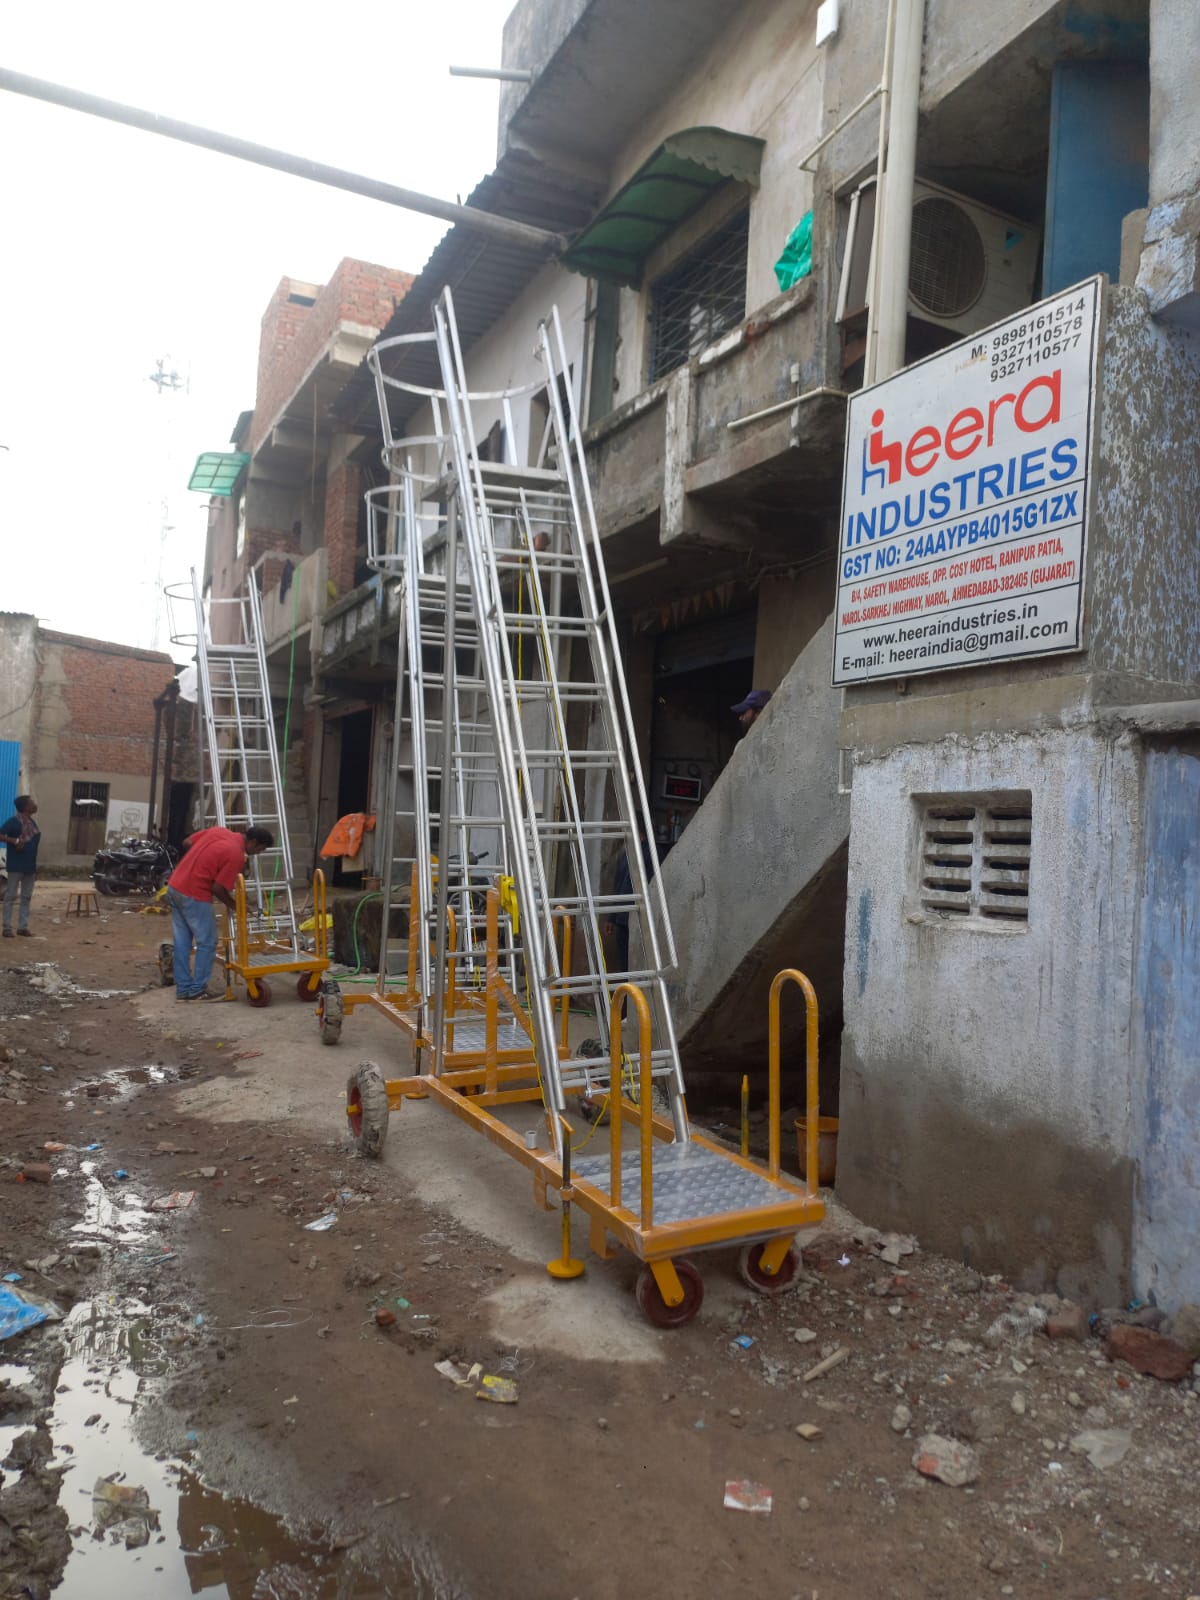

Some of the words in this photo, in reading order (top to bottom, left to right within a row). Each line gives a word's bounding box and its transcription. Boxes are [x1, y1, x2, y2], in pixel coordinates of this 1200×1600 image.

[971, 344, 987, 360] M:
[993, 297, 1085, 350] 9898161514
[990, 333, 1082, 382] 9327110577
[991, 316, 1083, 366] 9327110578
[861, 369, 1062, 496] heera
[847, 437, 1078, 547] INDUSTRIES
[843, 552, 872, 578] GST
[875, 545, 901, 571] NO:
[905, 490, 1078, 562] 24AAYPB4015G1ZX
[842, 602, 892, 626] NAROL-SARKHEJ
[892, 596, 924, 616] HIGHWAY,
[925, 590, 950, 608] NAROL,
[952, 571, 1029, 602] AHMEDABAD-382405
[1030, 560, 1076, 589] (GUJARAT)
[863, 582, 887, 600] SAFETY
[888, 571, 931, 594] WAREHOUSE,
[932, 567, 948, 583] OPP.
[949, 561, 969, 579] COSY
[969, 555, 997, 574] HOTEL,
[999, 544, 1036, 568] RANIPUR
[1037, 538, 1064, 558] PATIA,
[842, 650, 885, 671] E-mail:
[889, 620, 1069, 663] heeraindia@gmail.com
[863, 603, 1038, 649] www.heeraindustries.in
